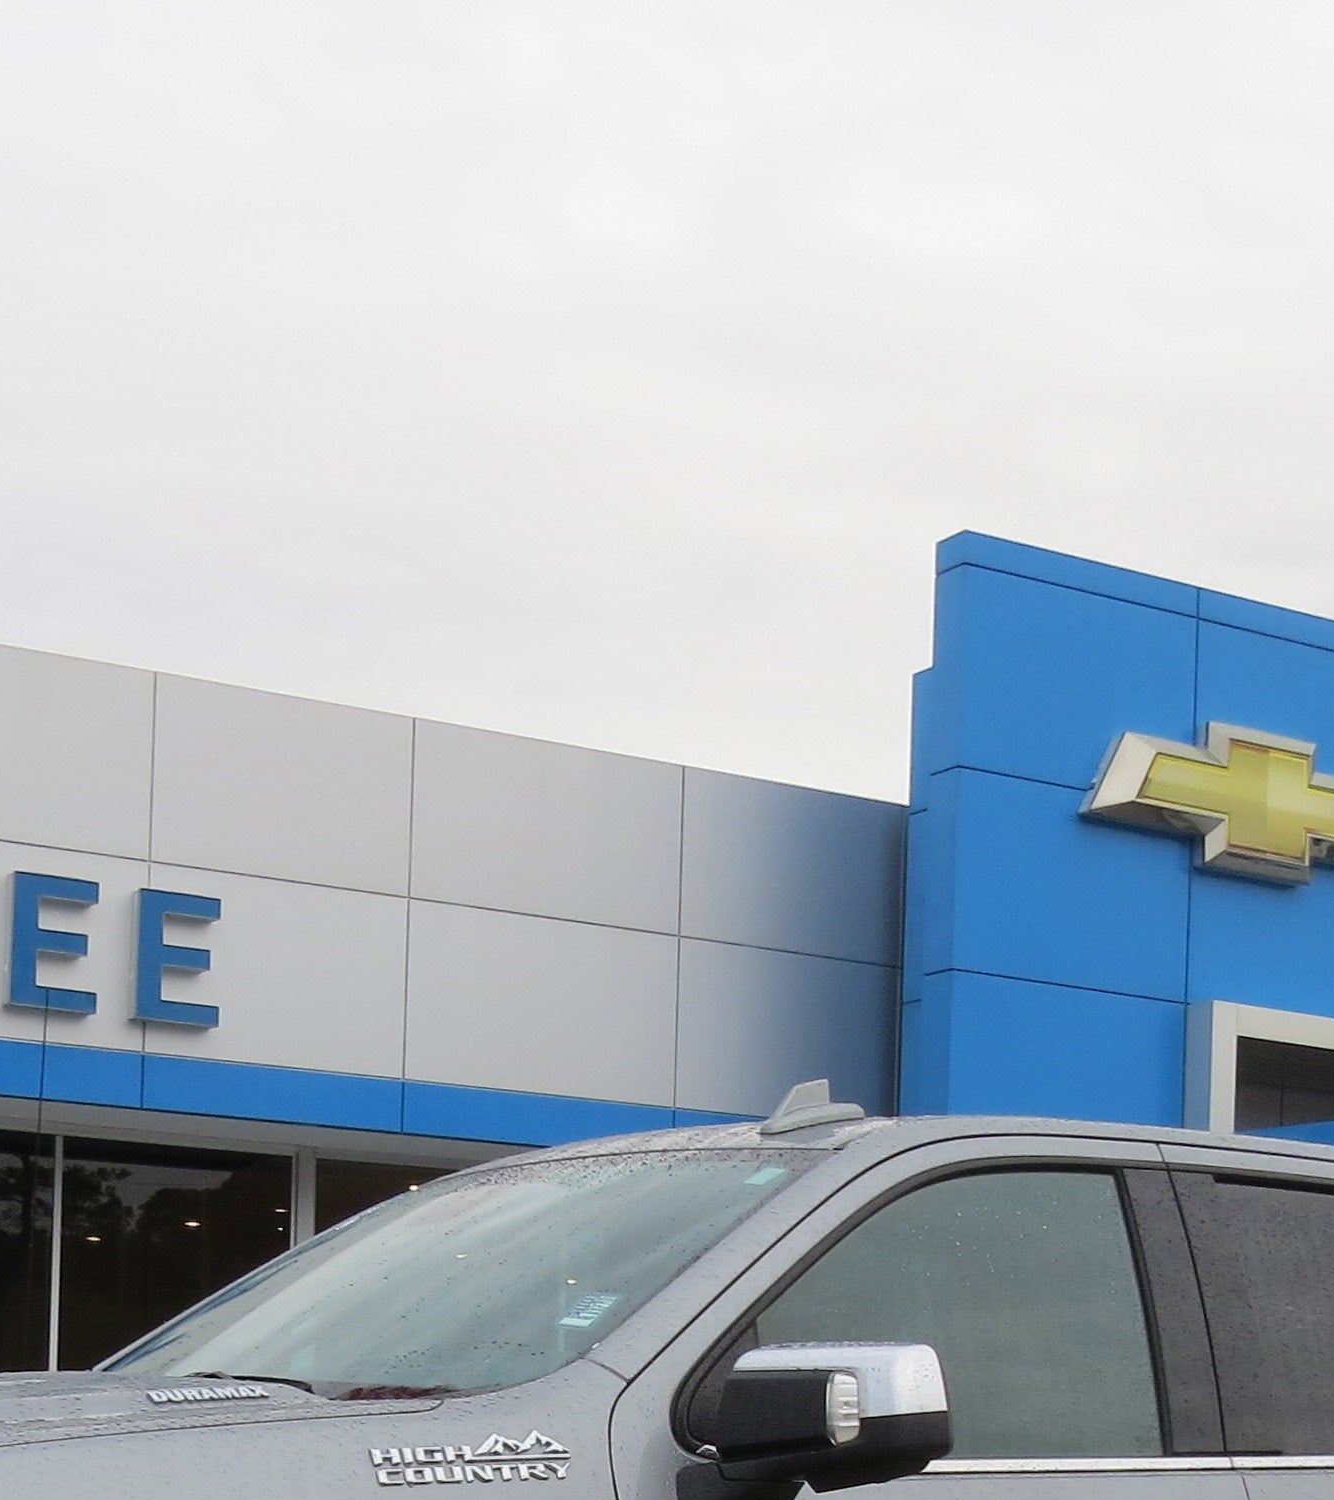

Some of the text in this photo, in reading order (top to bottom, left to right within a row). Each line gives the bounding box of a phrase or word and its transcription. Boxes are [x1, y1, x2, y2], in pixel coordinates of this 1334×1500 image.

[147, 1385, 270, 1403] DURAMAX
[370, 1445, 474, 1467] HIGH
[375, 1462, 571, 1486] COUNTRY
